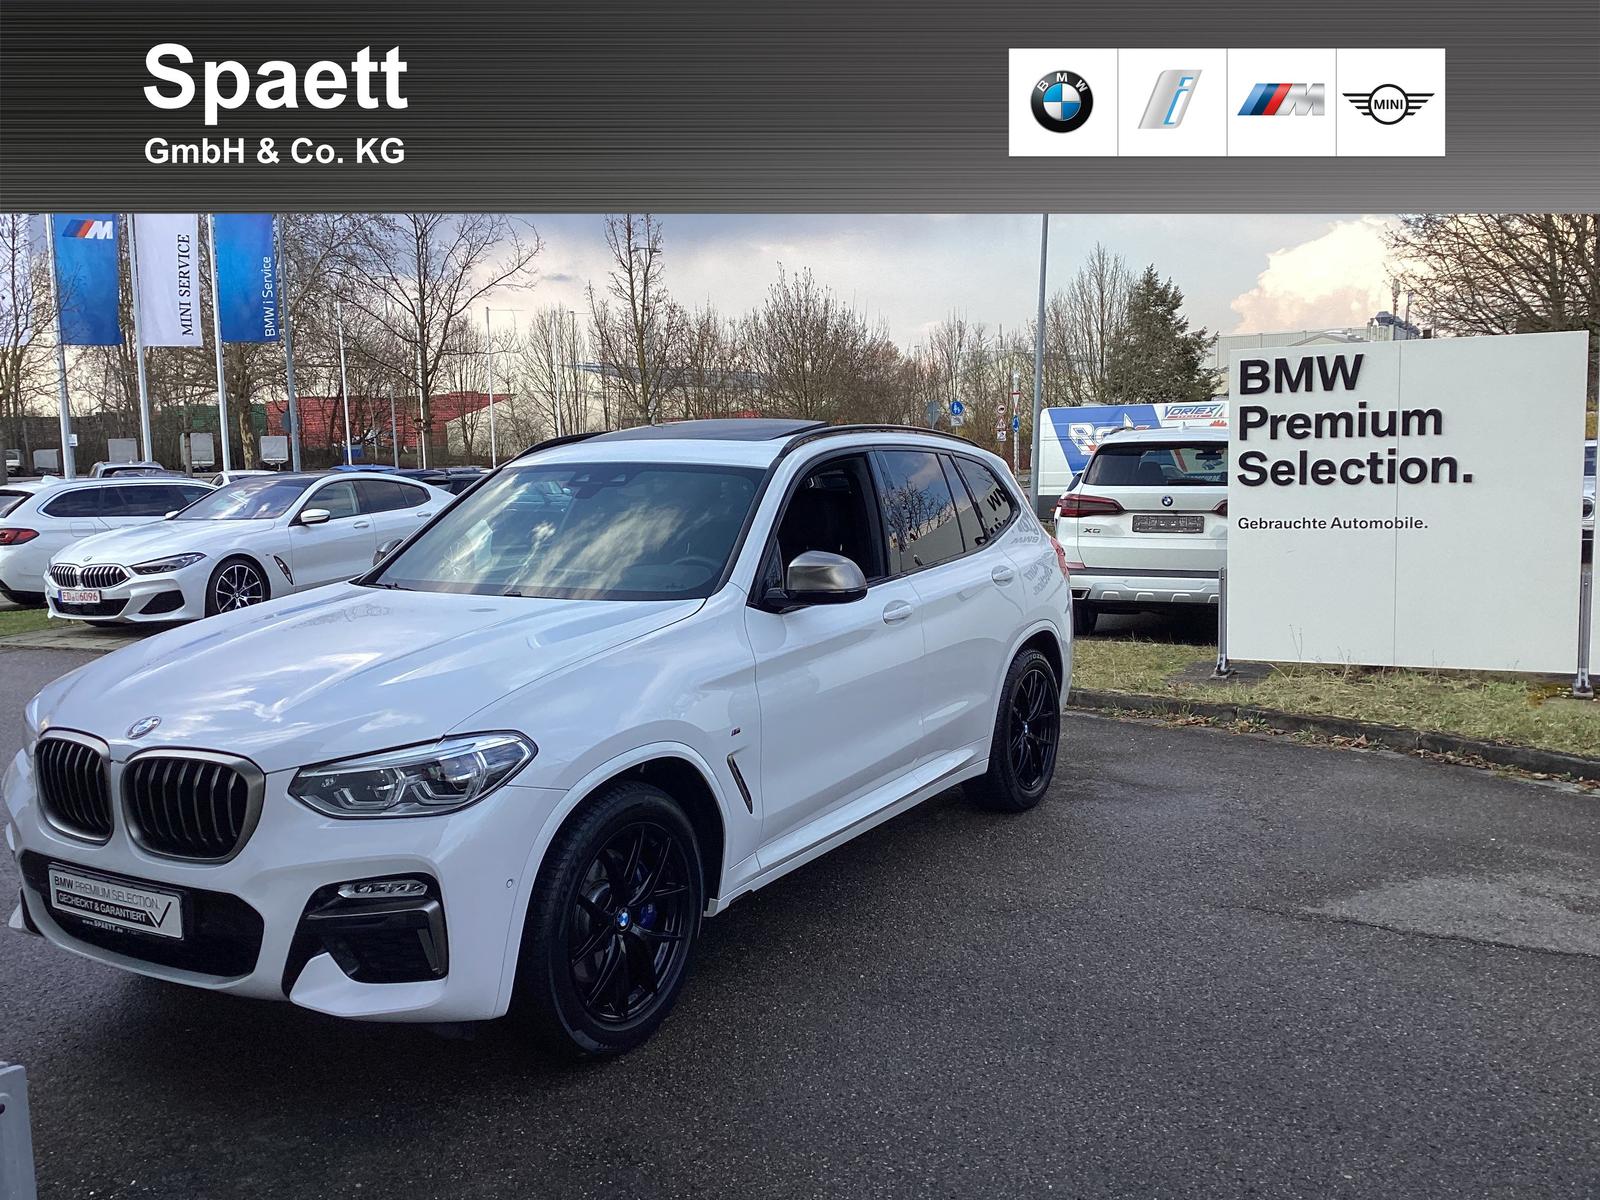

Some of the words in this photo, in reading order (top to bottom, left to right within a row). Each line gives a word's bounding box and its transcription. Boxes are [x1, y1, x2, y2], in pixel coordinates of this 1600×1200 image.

[177, 234, 191, 298] SERVICE
[261, 256, 274, 299] Service
[179, 302, 194, 336] MINI
[264, 307, 276, 337] BMW
[1239, 353, 1364, 395] BMW
[1239, 401, 1443, 441] Premium
[1237, 448, 1474, 487] Selection.
[1237, 517, 1327, 530] Gebrauchte
[1330, 516, 1429, 530] Automobile.
[54, 876, 74, 890] BMW
[75, 881, 111, 900] PREMIUM
[58, 892, 94, 911] GECHECKT
[94, 903, 100, 911] &
[100, 903, 147, 923] GARANTIERT
